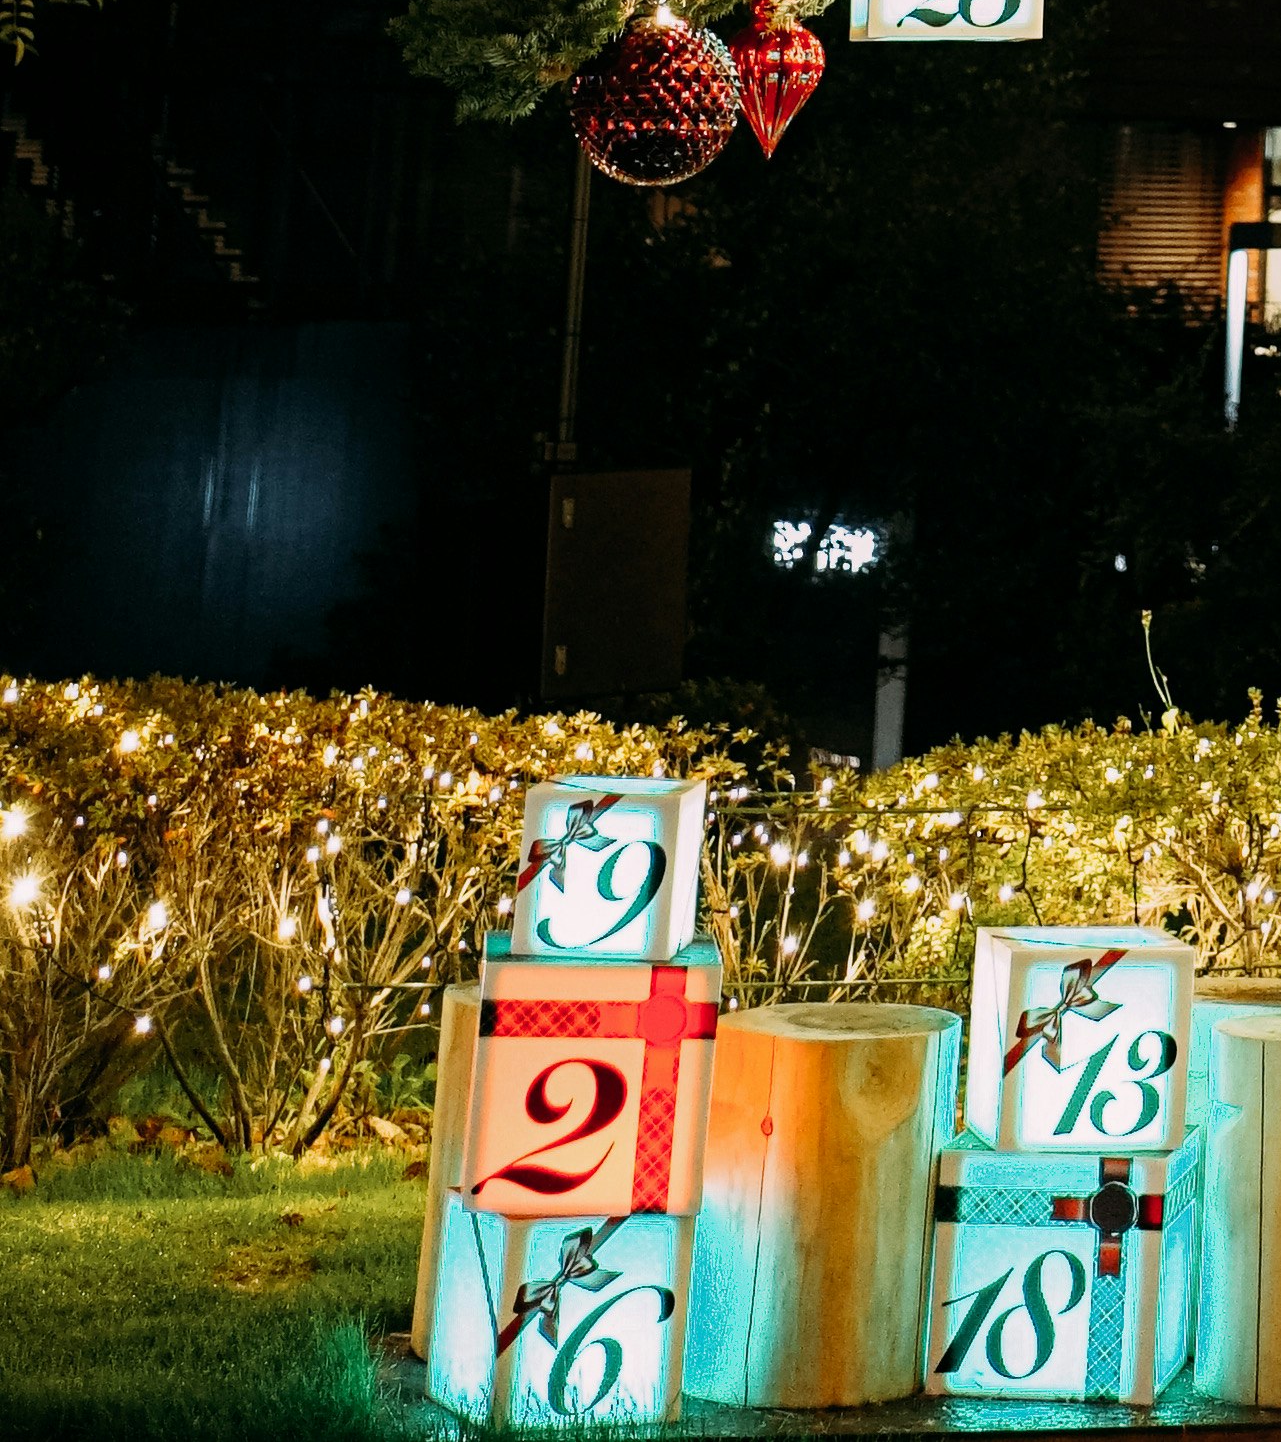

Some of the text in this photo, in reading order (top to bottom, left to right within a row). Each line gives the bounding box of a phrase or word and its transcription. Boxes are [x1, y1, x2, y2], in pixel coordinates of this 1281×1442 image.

[536, 840, 667, 949] 9
[471, 1058, 628, 1195] 2
[1053, 1029, 1178, 1137] 13
[547, 1284, 676, 1417] 6
[933, 1249, 1086, 1380] 18
